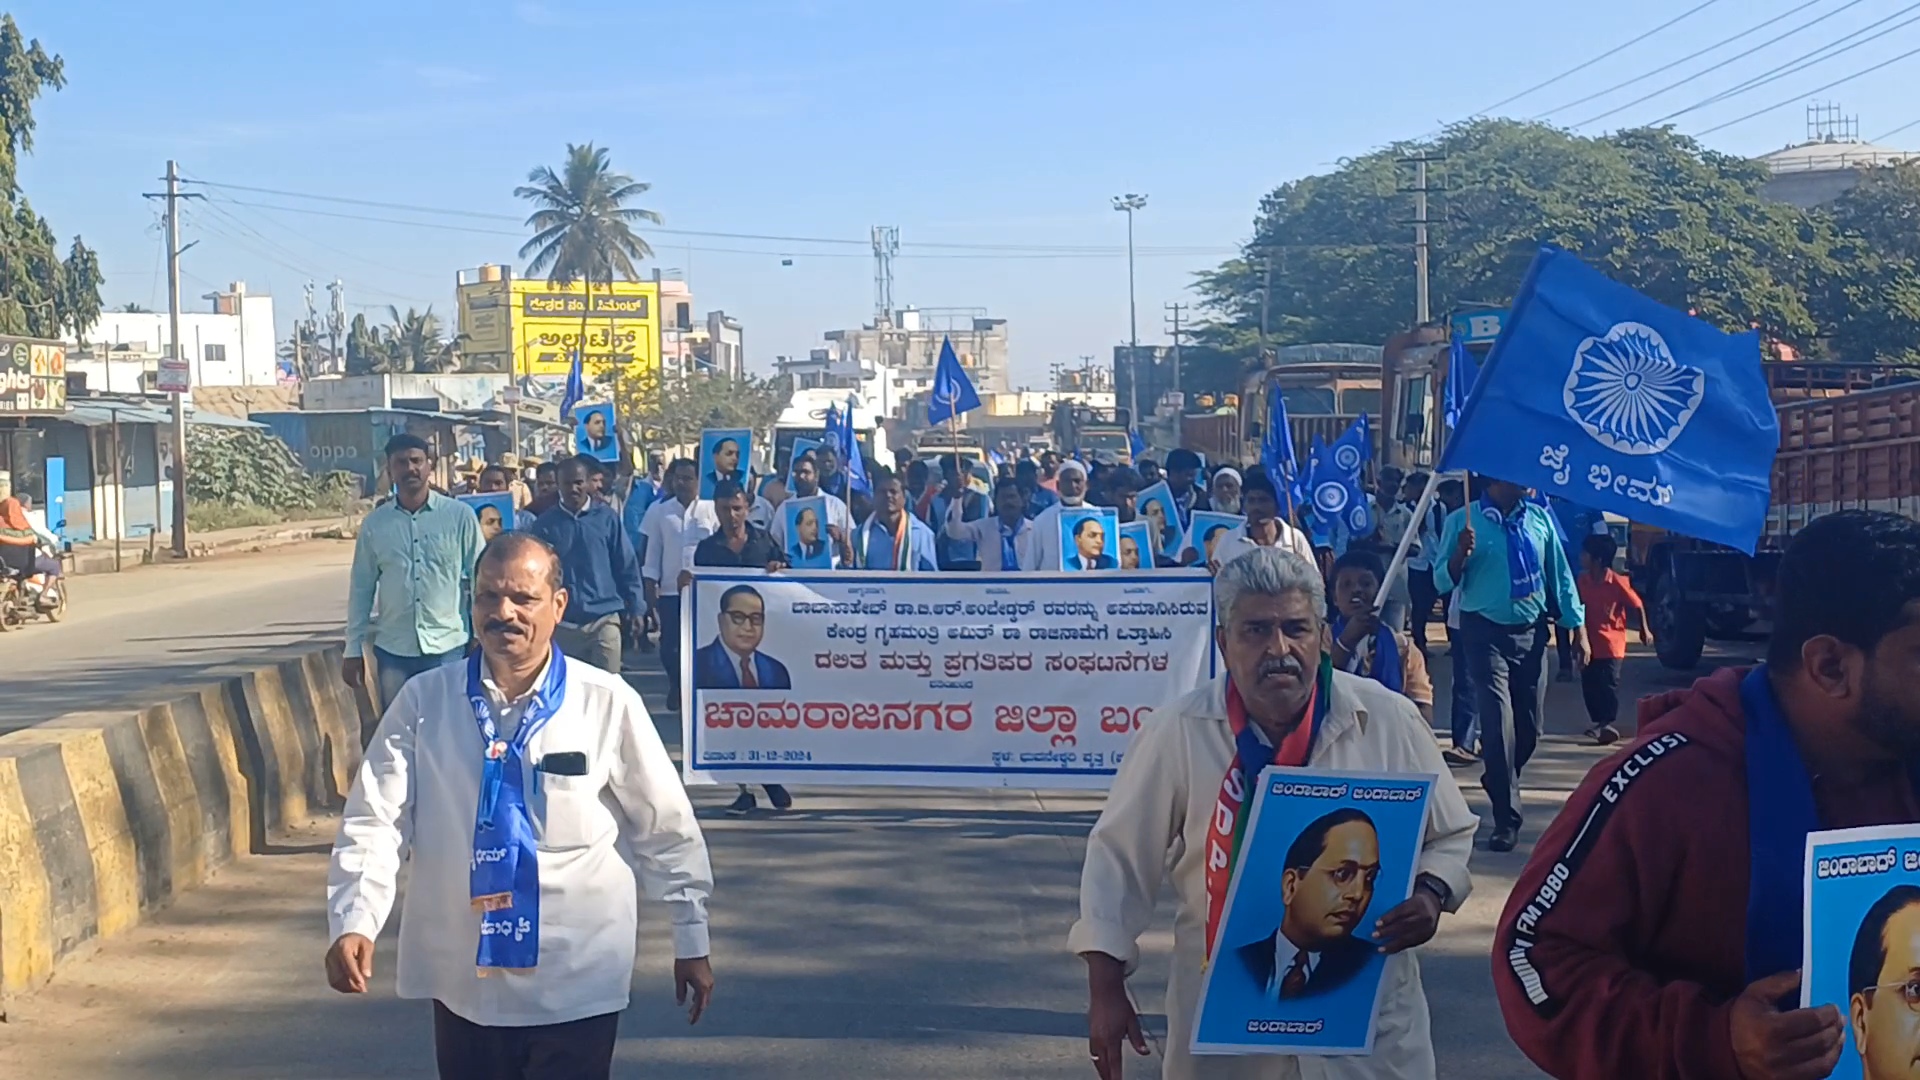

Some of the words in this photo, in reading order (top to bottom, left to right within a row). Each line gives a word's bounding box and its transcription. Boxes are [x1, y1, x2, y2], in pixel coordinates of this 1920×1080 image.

[1539, 443, 1571, 485] ಜೈ
[1587, 463, 1675, 506] ಭೀಮ್
[1043, 600, 1099, 622] ರವರನ್ನು
[1106, 600, 1209, 616] ಅಪಮಾನಿಸಿರುವ
[826, 623, 868, 644] ಕೇಂದ್ರ
[874, 624, 940, 646] ಗೃಹಮಂತ್ರಿ
[947, 623, 994, 641] ಅಮಿತ್
[814, 650, 867, 669] ದಲಿತ
[879, 650, 932, 678] ಮತ್ತು
[944, 650, 1033, 678] ಪ್ರಗತಿಪರ
[1045, 650, 1169, 675] ಸಂಘಟನೆಗಳ
[705, 699, 973, 732] ಚಾಮರಾಜನಗರ
[995, 705, 1077, 747] ಜಿಲ್ಲಾ
[748, 750, 813, 761] 31-12-2024
[1516, 903, 1543, 936] FM
[1535, 862, 1570, 909] 1980
